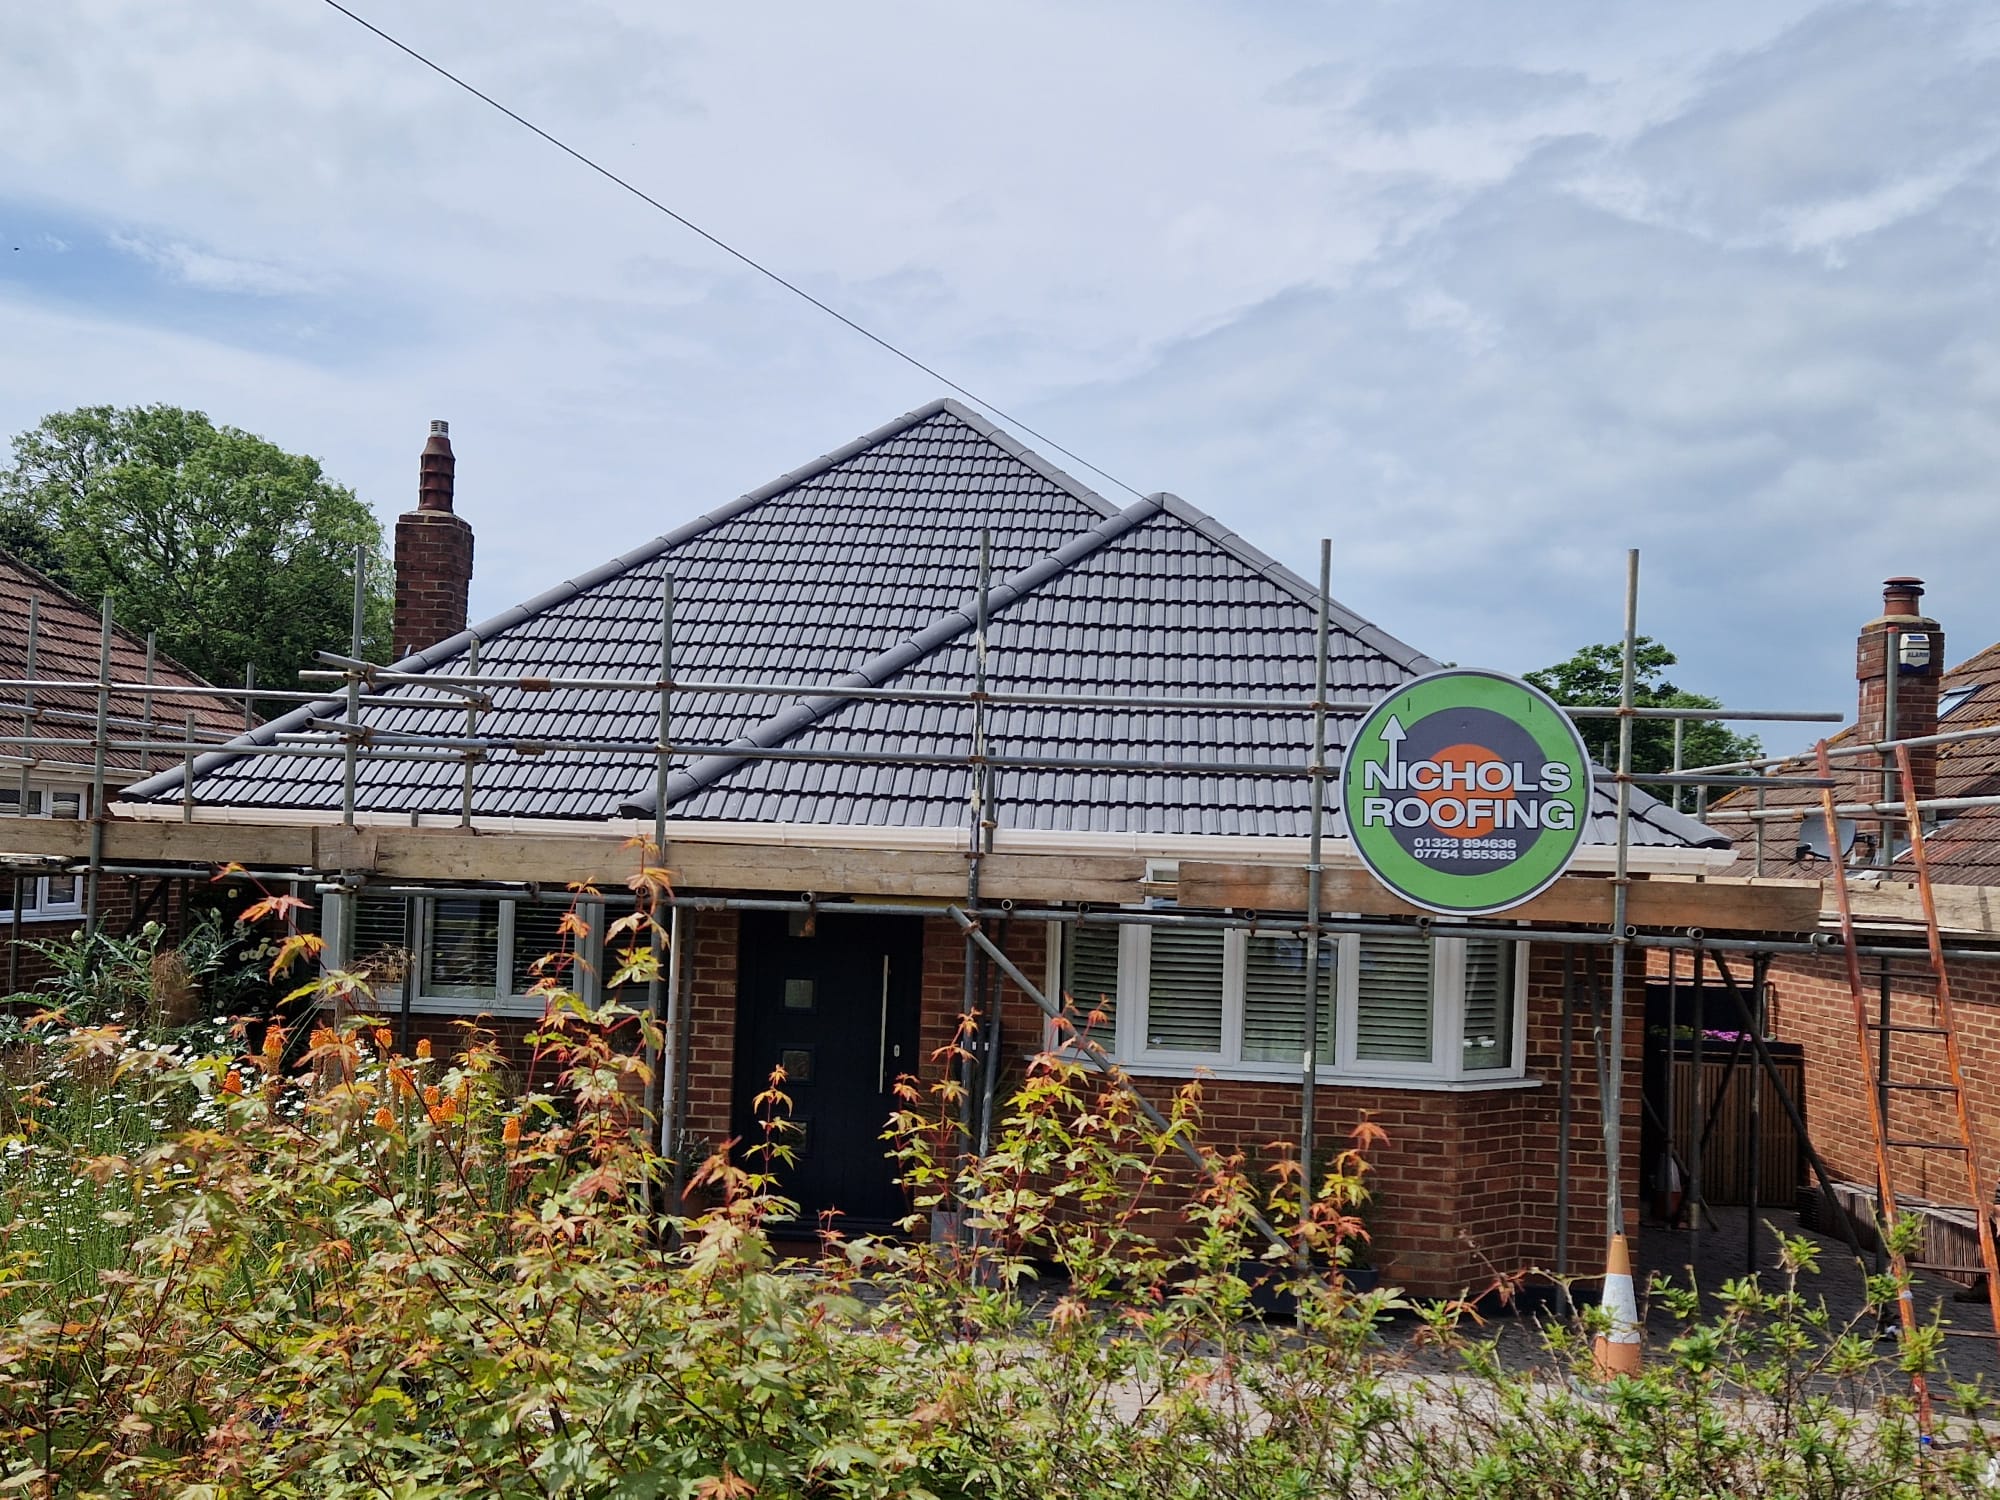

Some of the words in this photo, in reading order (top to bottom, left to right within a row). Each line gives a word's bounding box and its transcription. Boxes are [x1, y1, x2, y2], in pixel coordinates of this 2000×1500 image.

[1363, 760, 1572, 793] NICHOLS
[1363, 797, 1575, 830] ROOFING
[1414, 837, 1459, 848] 01323
[1462, 838, 1517, 849] 894636
[1414, 849, 1459, 859] 07754
[1462, 849, 1517, 860] 955363
